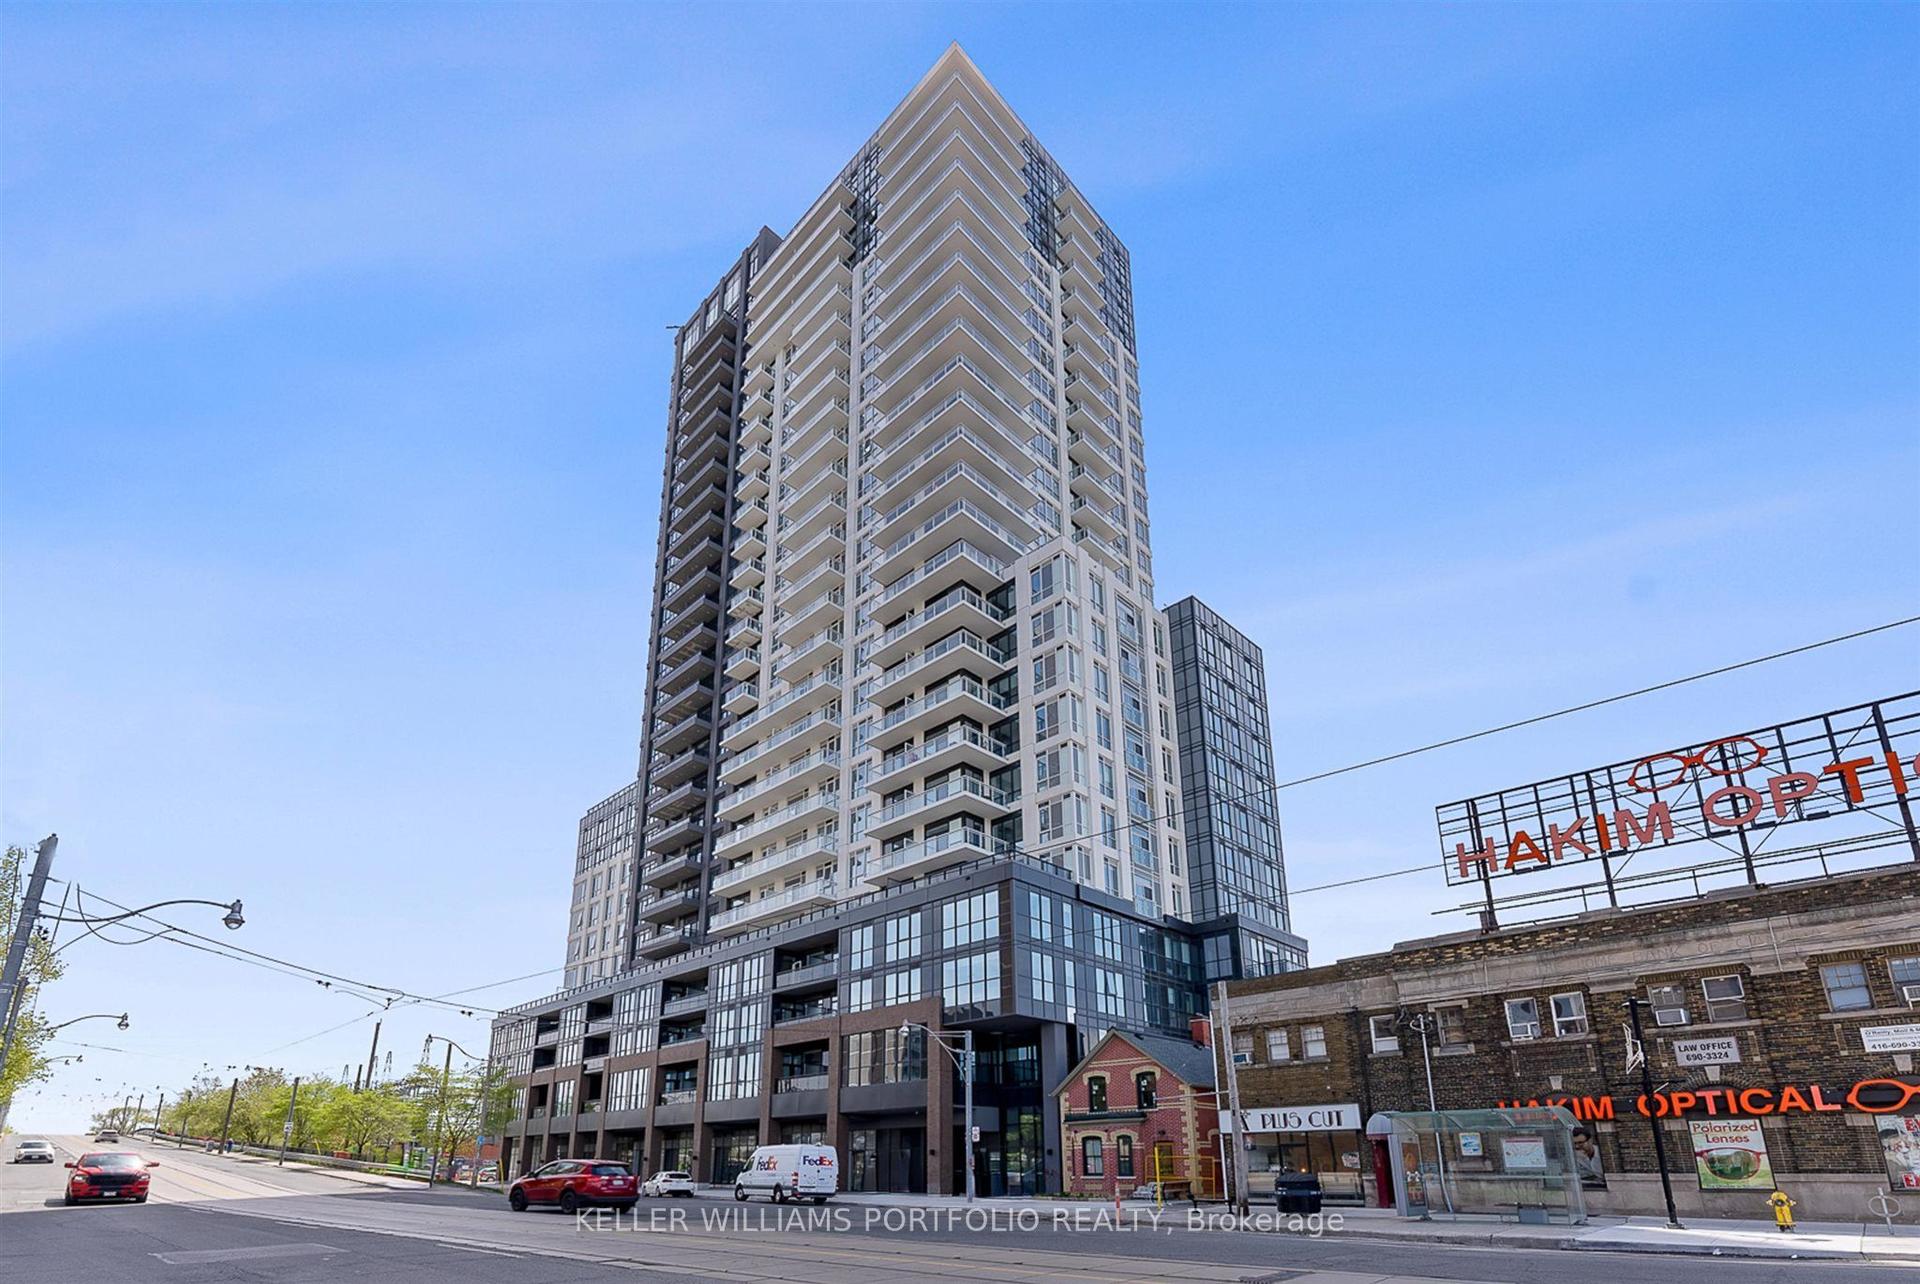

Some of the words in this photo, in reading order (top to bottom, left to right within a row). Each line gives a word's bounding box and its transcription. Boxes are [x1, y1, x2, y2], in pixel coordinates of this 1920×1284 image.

[1456, 801, 1675, 878] HAKIM
[1703, 751, 1920, 827] OPTI
[1678, 1044, 1697, 1052] LAW
[1700, 1041, 1733, 1051] OFFICE
[1686, 1051, 1729, 1061] 690-3324
[1637, 1085, 1841, 1117] OPTICAL
[1261, 1112, 1302, 1129] PLUS
[1308, 1109, 1344, 1128] CUT
[1693, 1120, 1758, 1133] Polarized
[1706, 1134, 1750, 1143] Lenses
[756, 1155, 778, 1171] FedEx
[803, 1155, 833, 1167] FedEx
